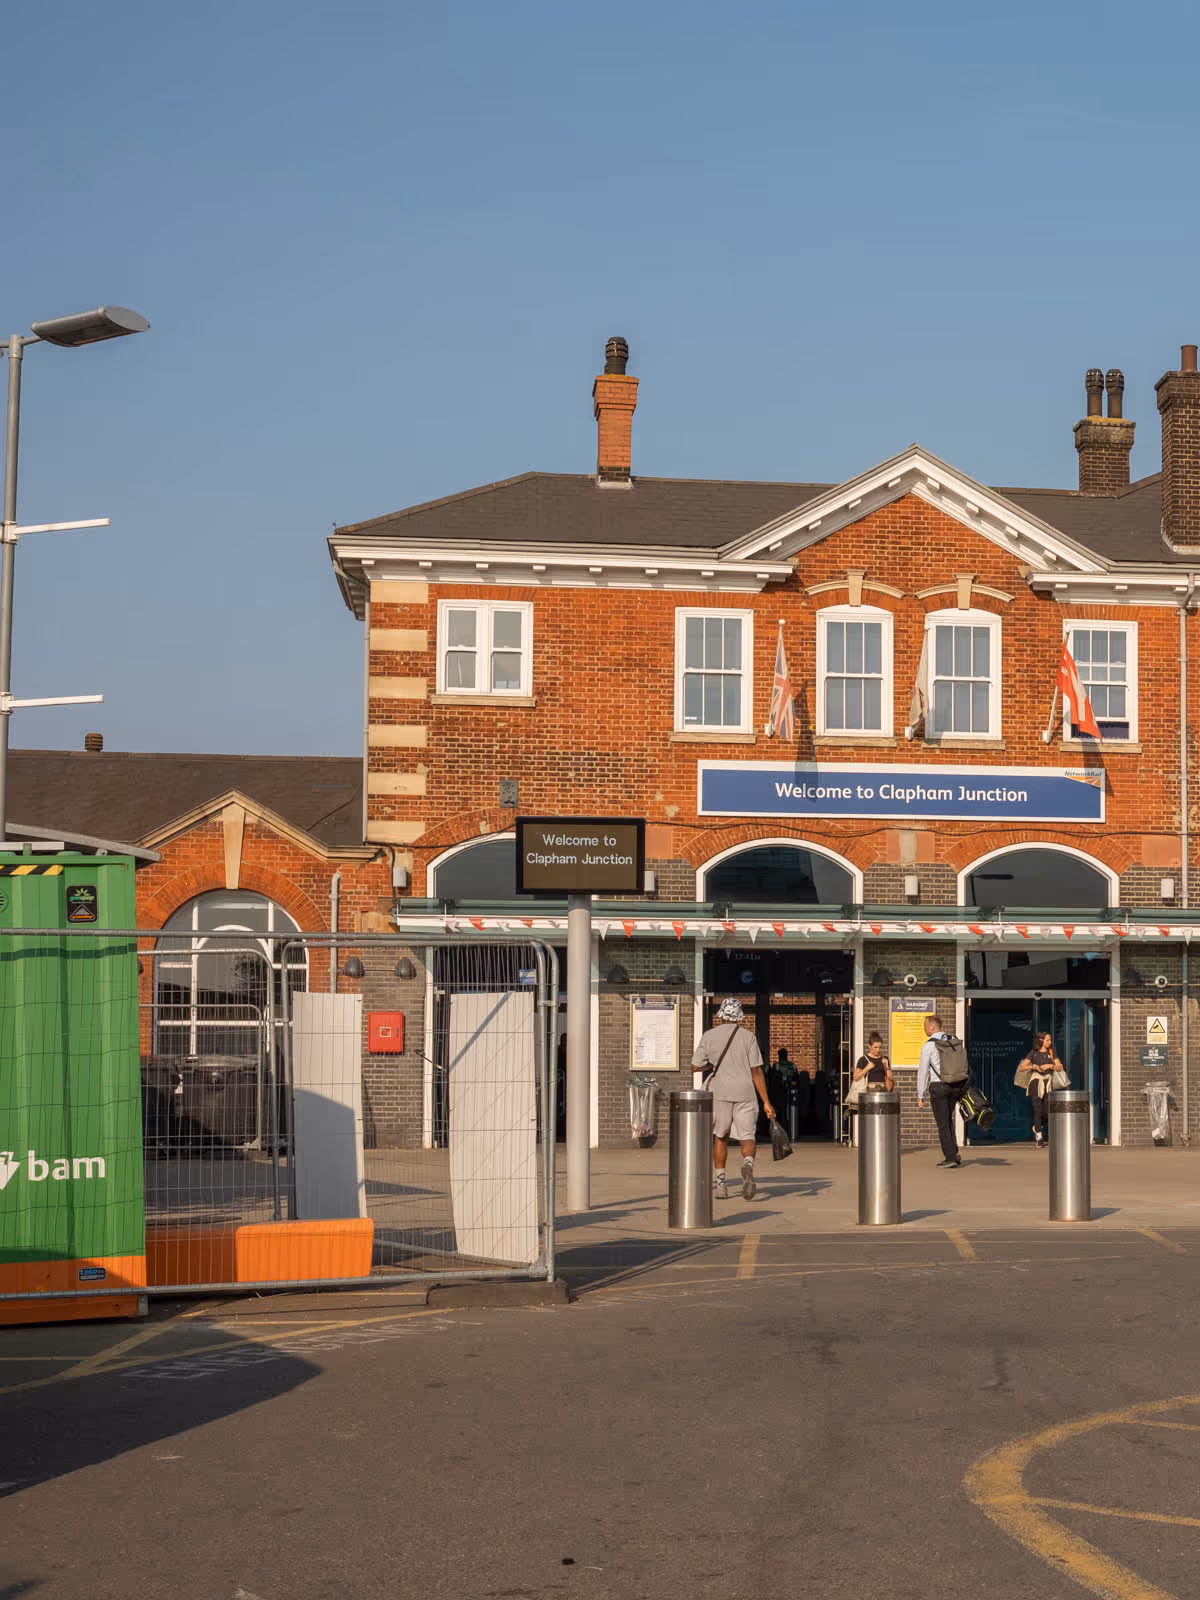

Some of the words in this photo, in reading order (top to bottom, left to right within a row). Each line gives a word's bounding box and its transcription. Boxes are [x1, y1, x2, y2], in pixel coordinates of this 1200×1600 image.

[775, 782, 852, 799] Welcome
[856, 785, 874, 799] to
[879, 784, 953, 804] Clapham
[958, 786, 1028, 802] Junction
[542, 833, 599, 846] Welcome
[604, 835, 617, 846] to
[526, 852, 577, 867] Clapham
[581, 853, 633, 865] Junction
[27, 1149, 106, 1181] bam
